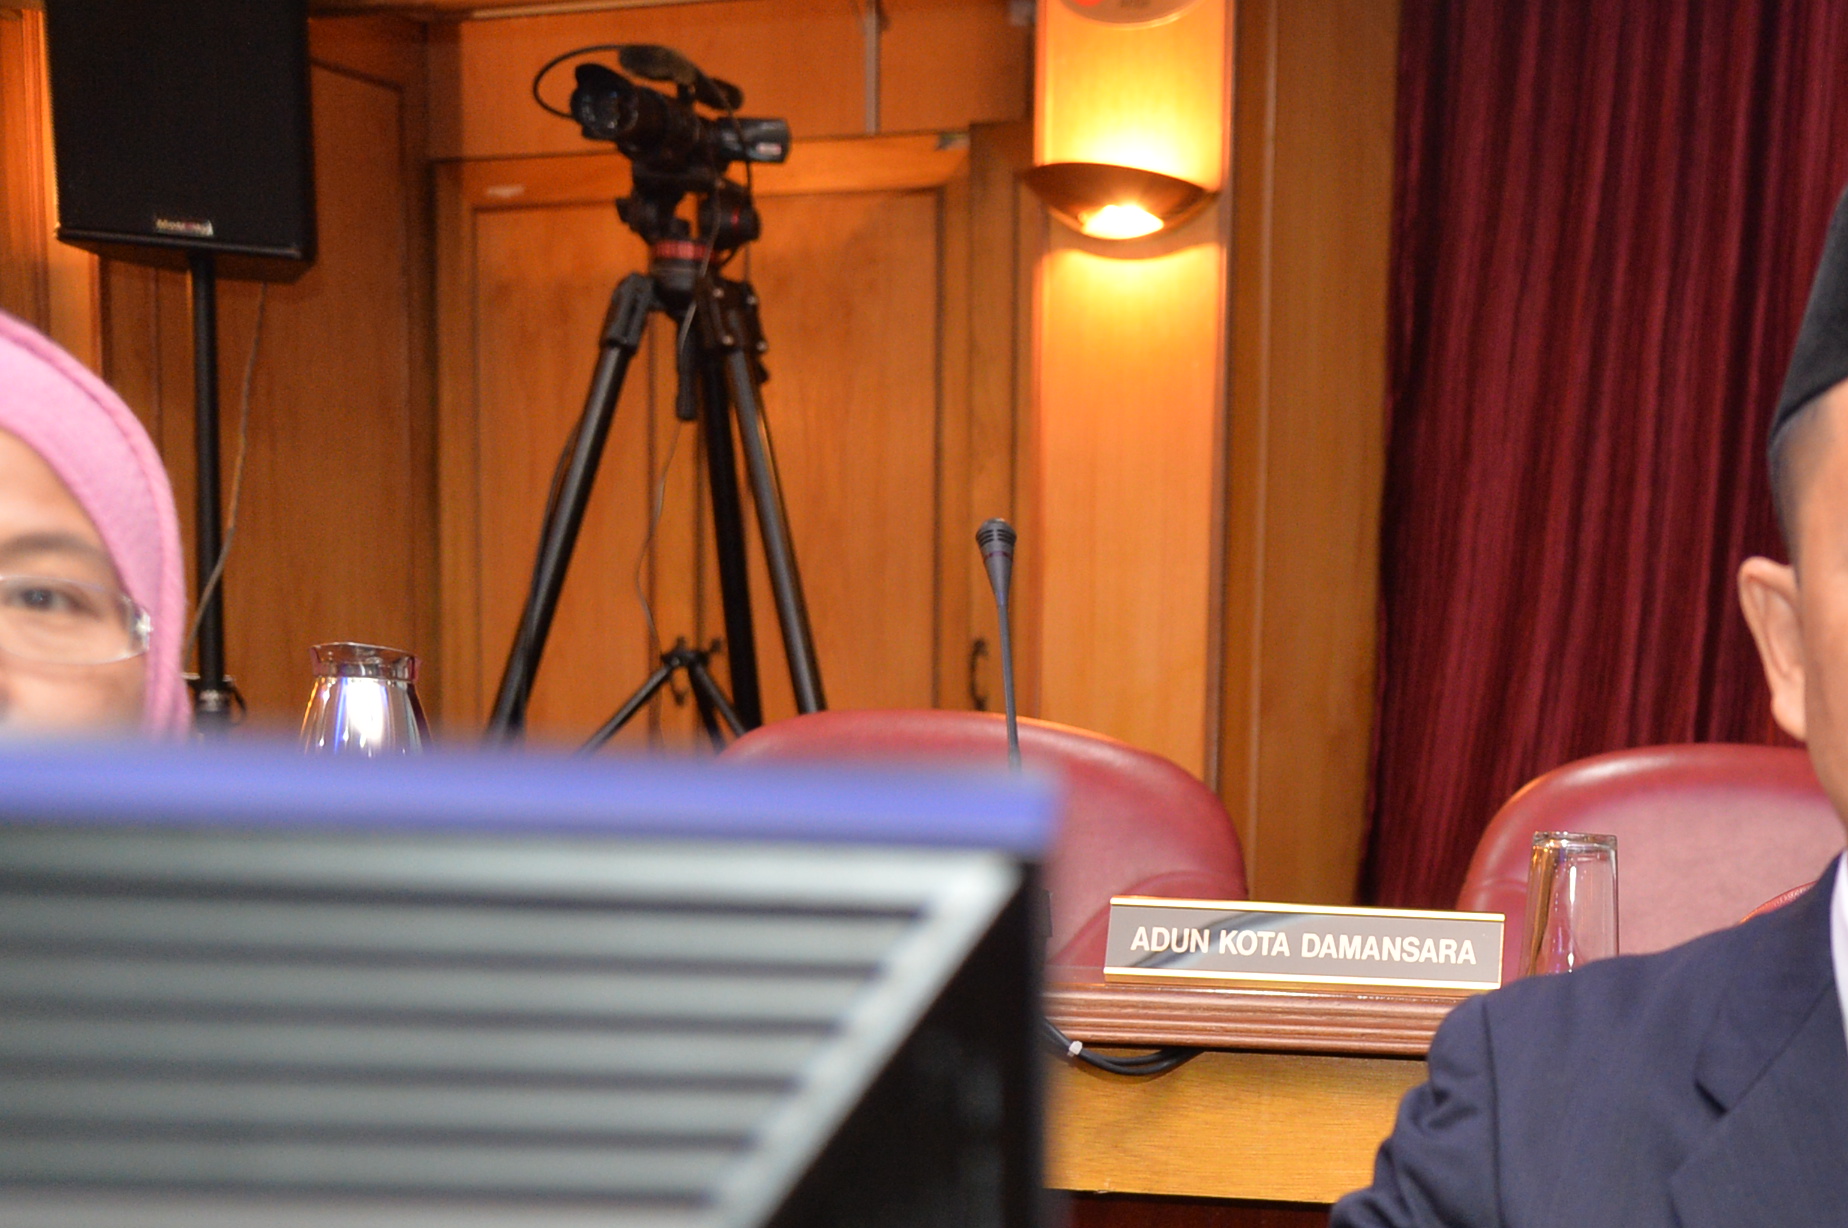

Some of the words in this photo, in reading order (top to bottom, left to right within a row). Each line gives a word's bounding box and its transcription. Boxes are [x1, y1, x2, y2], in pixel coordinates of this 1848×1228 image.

[1130, 926, 1210, 954] ADUN
[1219, 929, 1290, 957] KOTA
[1301, 932, 1477, 966] DAMANSARA
